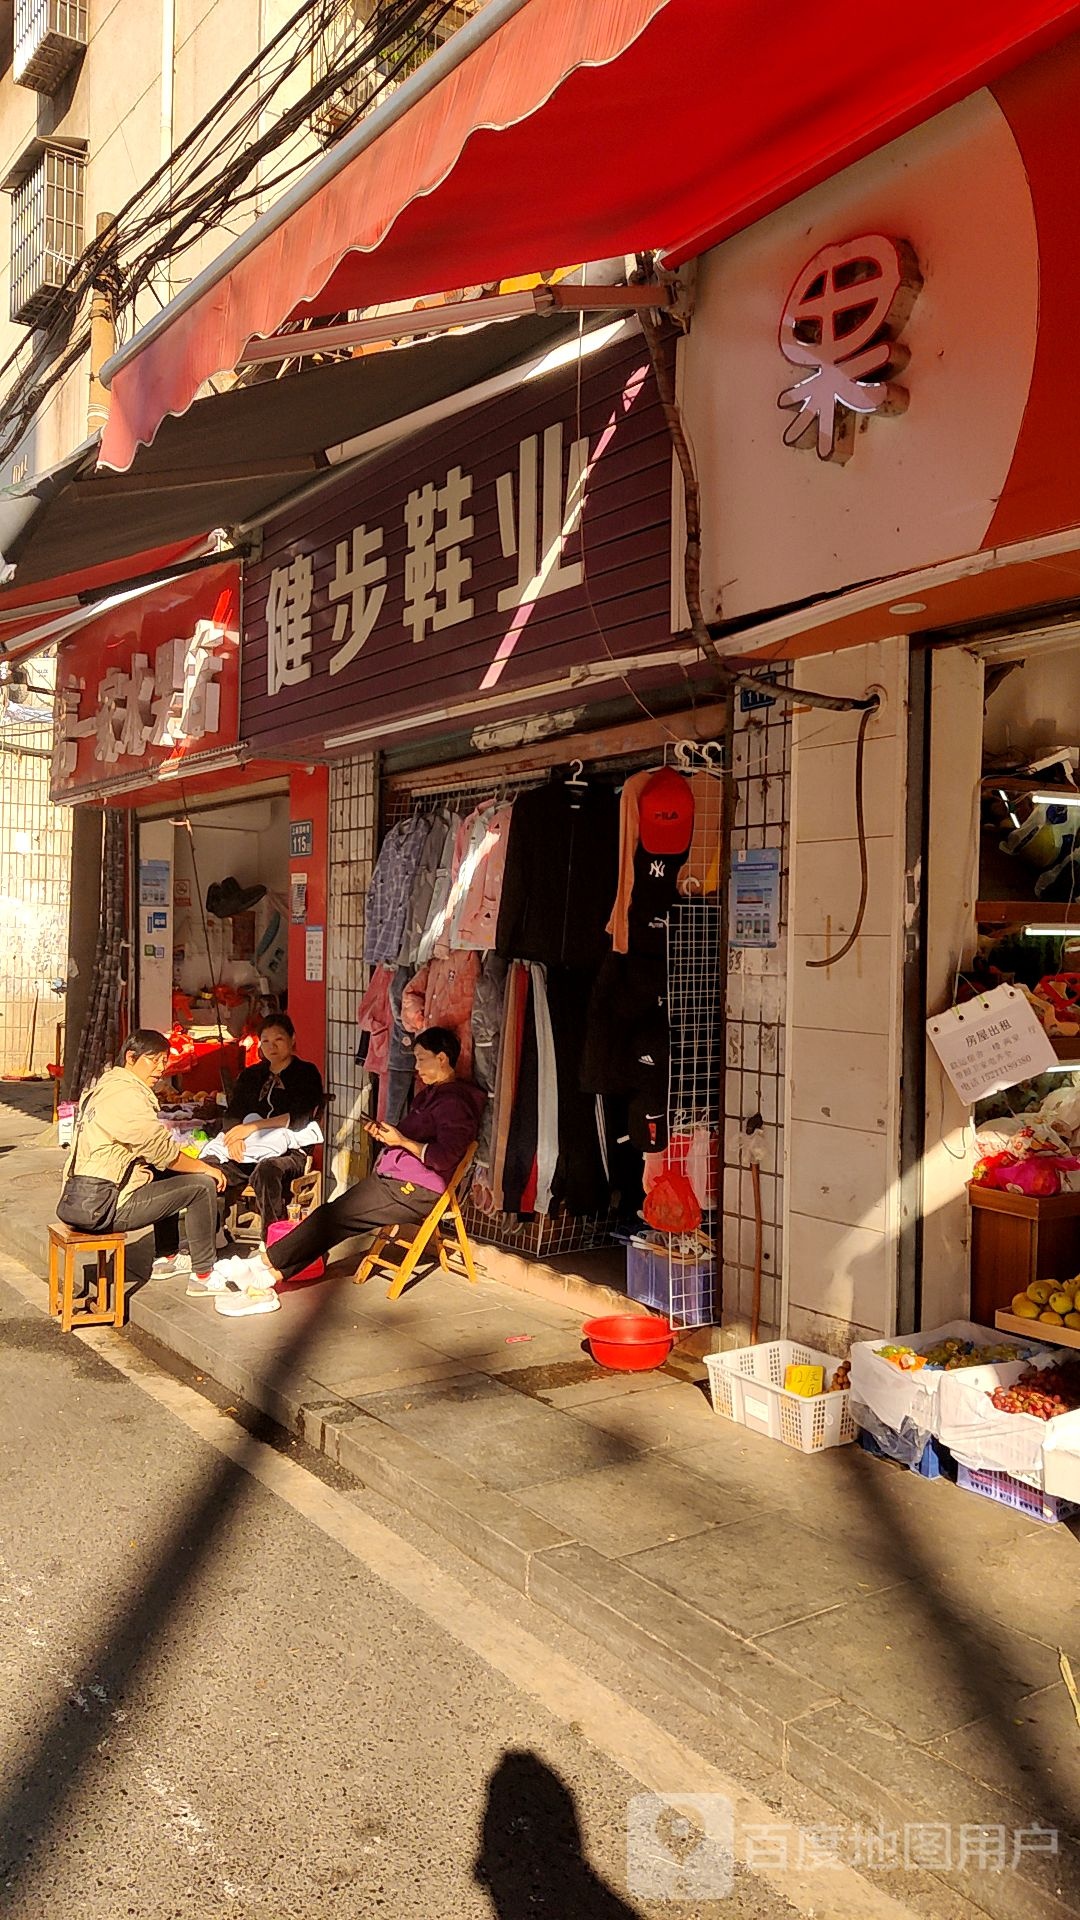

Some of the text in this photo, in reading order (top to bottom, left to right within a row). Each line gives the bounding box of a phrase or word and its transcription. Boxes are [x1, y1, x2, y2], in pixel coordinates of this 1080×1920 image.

[777, 234, 912, 463] 果
[265, 421, 590, 697] 健步鞋业
[654, 810, 679, 820] FILA
[292, 835, 307, 853] 115
[648, 860, 666, 878] NY
[966, 1019, 1012, 1048] 房屋出租
